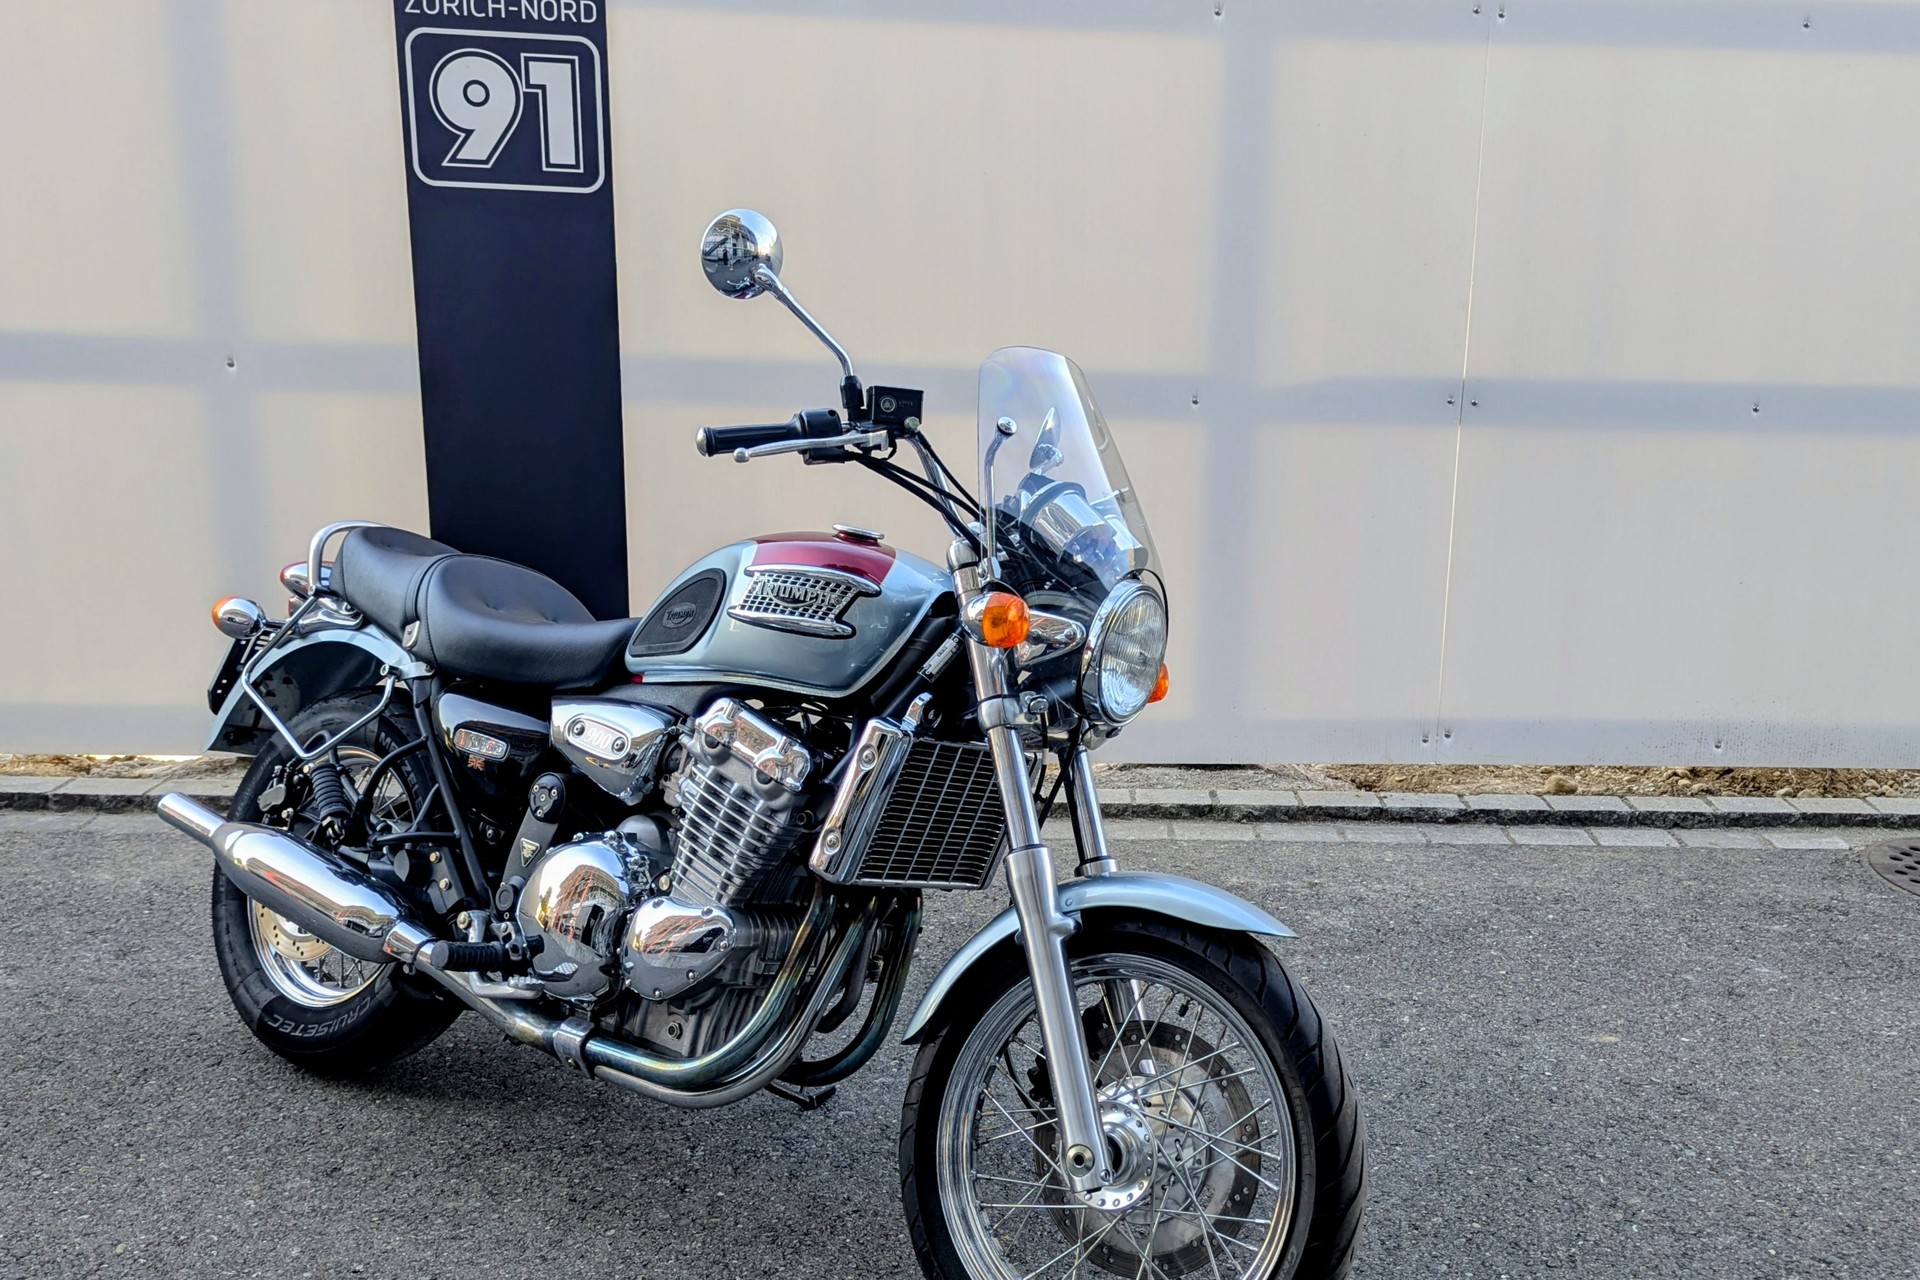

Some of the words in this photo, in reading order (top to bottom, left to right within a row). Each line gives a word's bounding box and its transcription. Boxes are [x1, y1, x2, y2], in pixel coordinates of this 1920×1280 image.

[429, 47, 584, 173] 91
[757, 578, 832, 606] TRIUMPH
[583, 727, 613, 749] 900
[267, 996, 371, 1037] CRUISETEC
